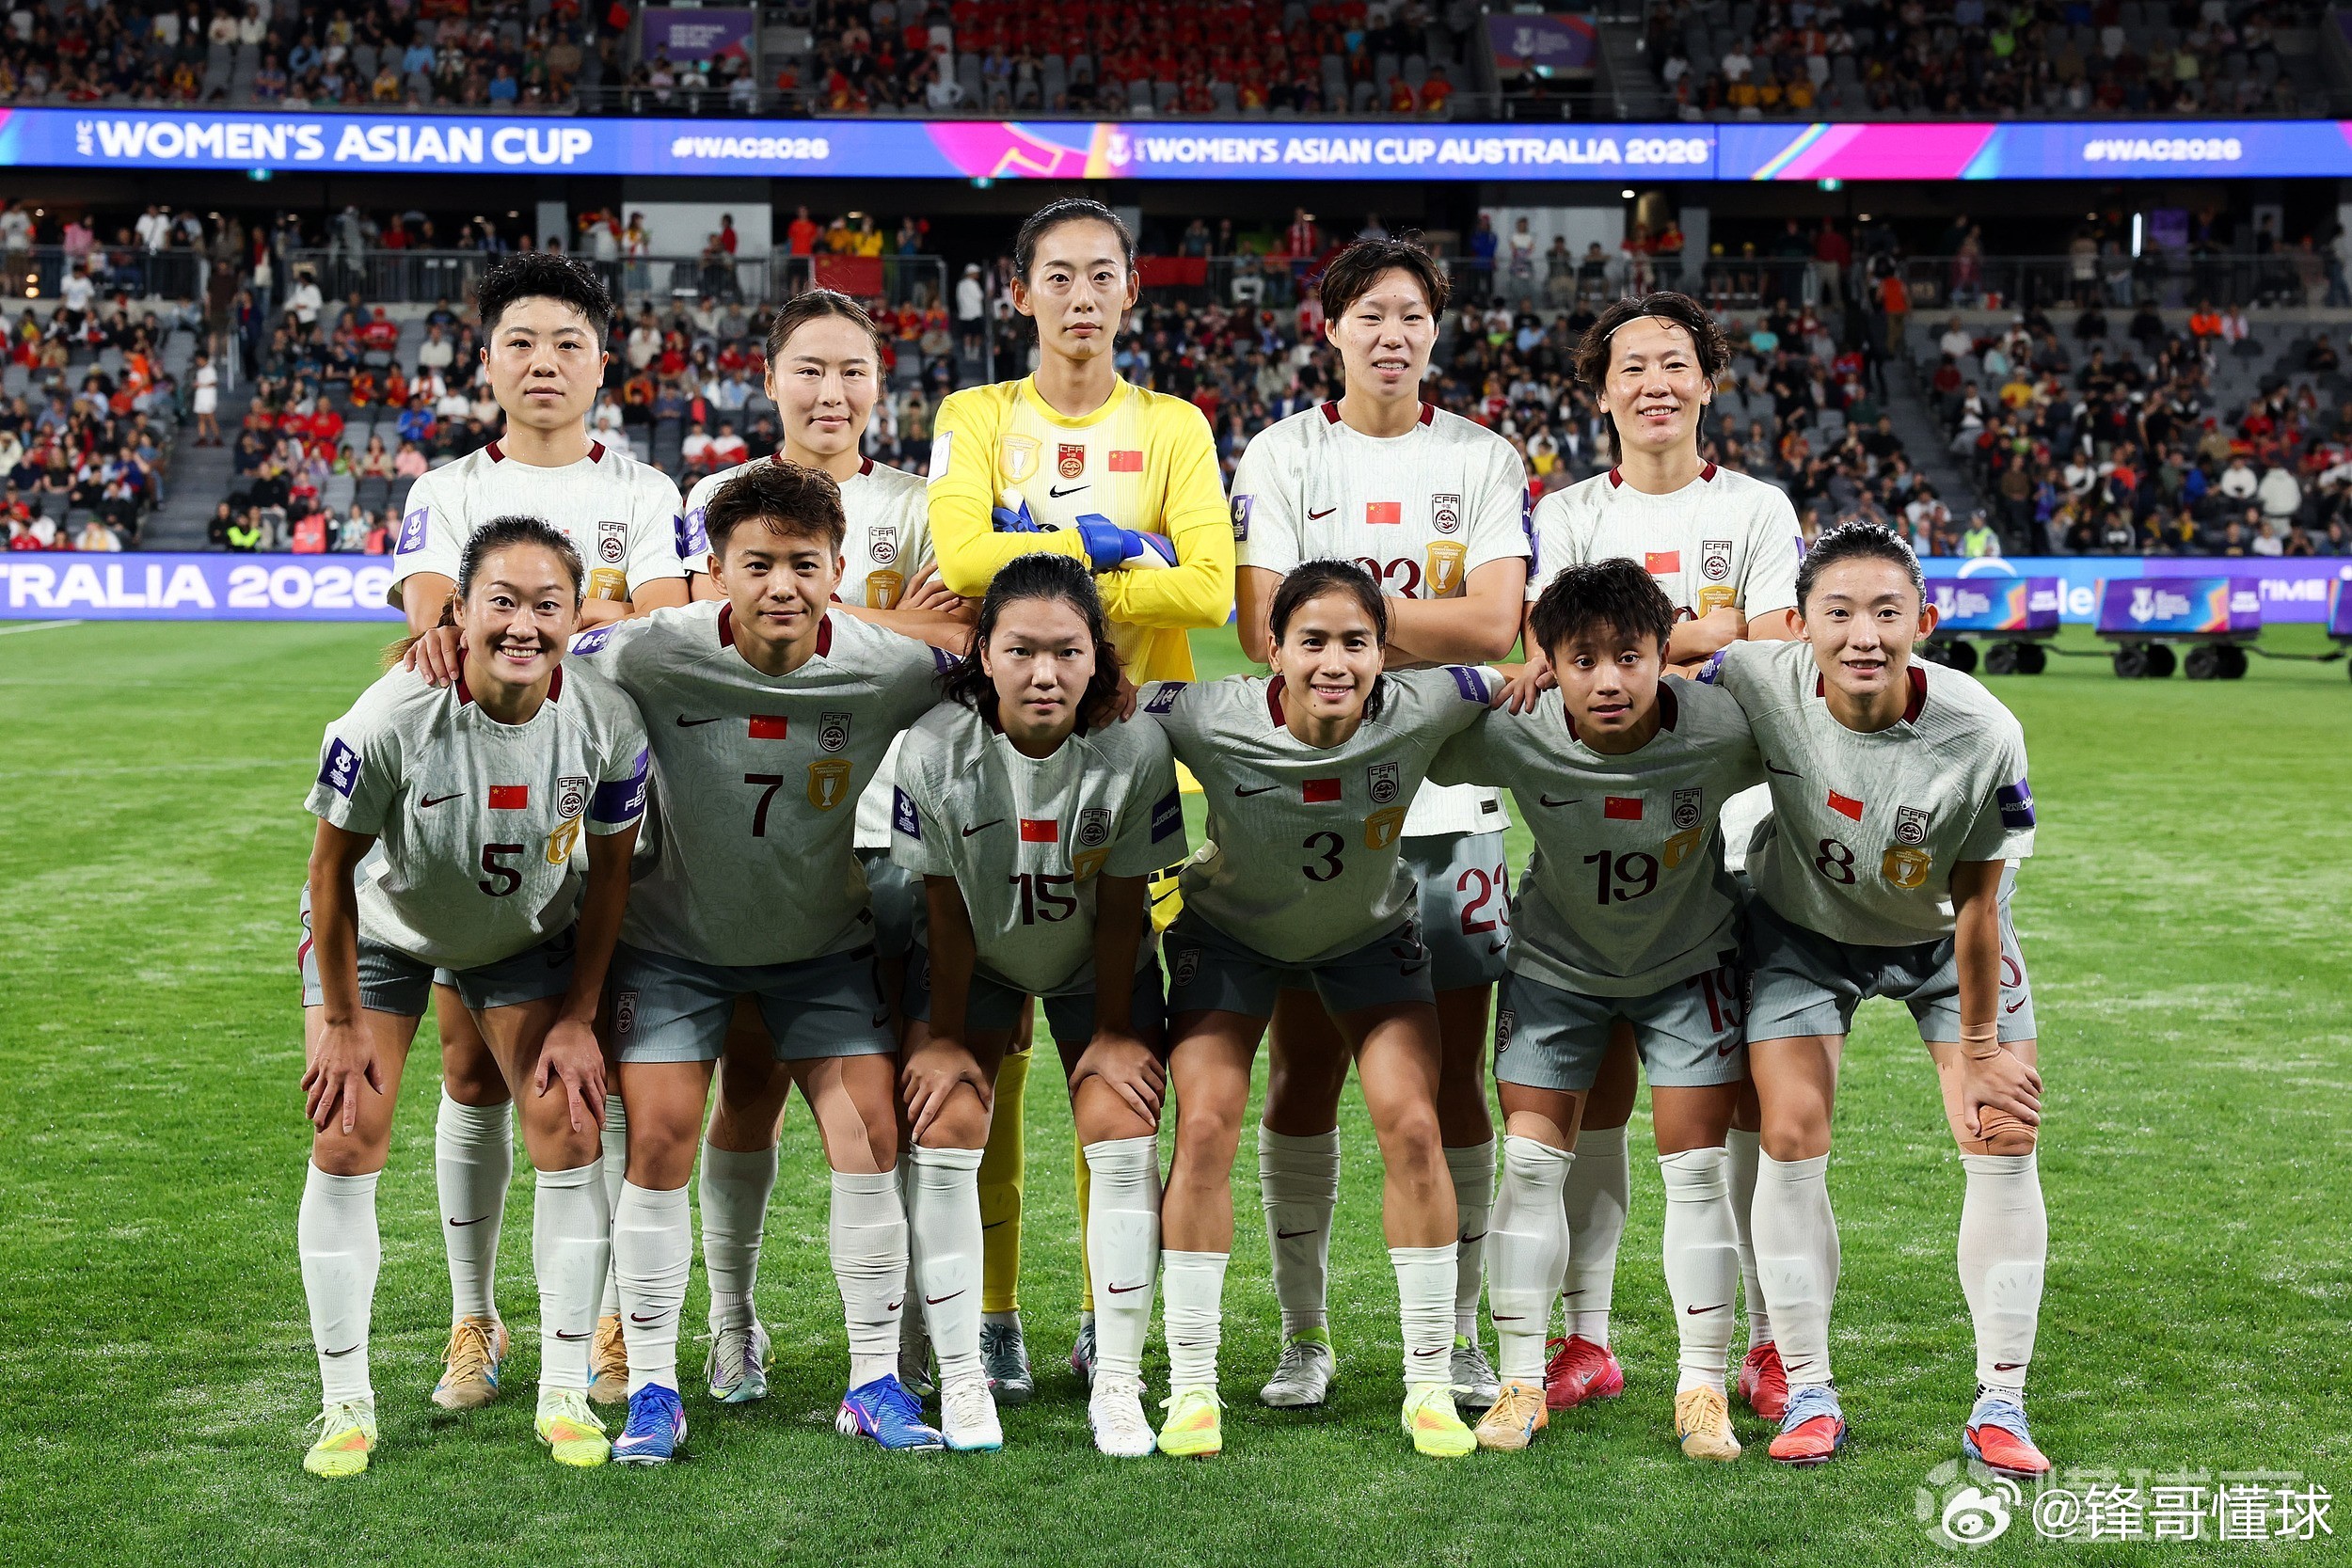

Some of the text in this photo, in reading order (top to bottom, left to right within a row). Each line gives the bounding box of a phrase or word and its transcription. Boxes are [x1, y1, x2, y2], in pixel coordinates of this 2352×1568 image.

[95, 120, 325, 160] WOMEN'S
[334, 124, 484, 164] ASIAN
[490, 127, 593, 166] CUP
[672, 136, 830, 160] #WAC2026
[1146, 137, 1279, 164] WOMEN'S
[1283, 138, 1372, 165] ASIAN
[1374, 138, 1437, 165] CUP
[1437, 138, 1621, 165] AUSTRALIA
[1626, 139, 1708, 165] 2026
[2083, 138, 2243, 162] #WAC2026
[1058, 444, 1083, 454] CFA
[1433, 495, 1458, 504] CFA
[601, 523, 626, 533] CFA
[870, 528, 895, 537] CFA
[1704, 543, 1729, 551] CFA
[0, 563, 393, 610] RALIA 2026
[823, 712, 850, 722] CFA
[1369, 765, 1396, 776] CFA
[560, 779, 585, 789] CFA
[1675, 791, 1700, 800] CFA
[744, 773, 784, 837] 7
[1083, 811, 1108, 819] CFA
[1899, 809, 1928, 821] CFA
[1302, 831, 1345, 882] 3
[1816, 838, 1856, 885] 8
[478, 843, 525, 897] 5
[1583, 849, 1660, 906] 19
[1009, 872, 1078, 926] 15
[1456, 862, 1512, 936] 23
[619, 993, 637, 1002] CFA
[1500, 1011, 1514, 1022] CFA
